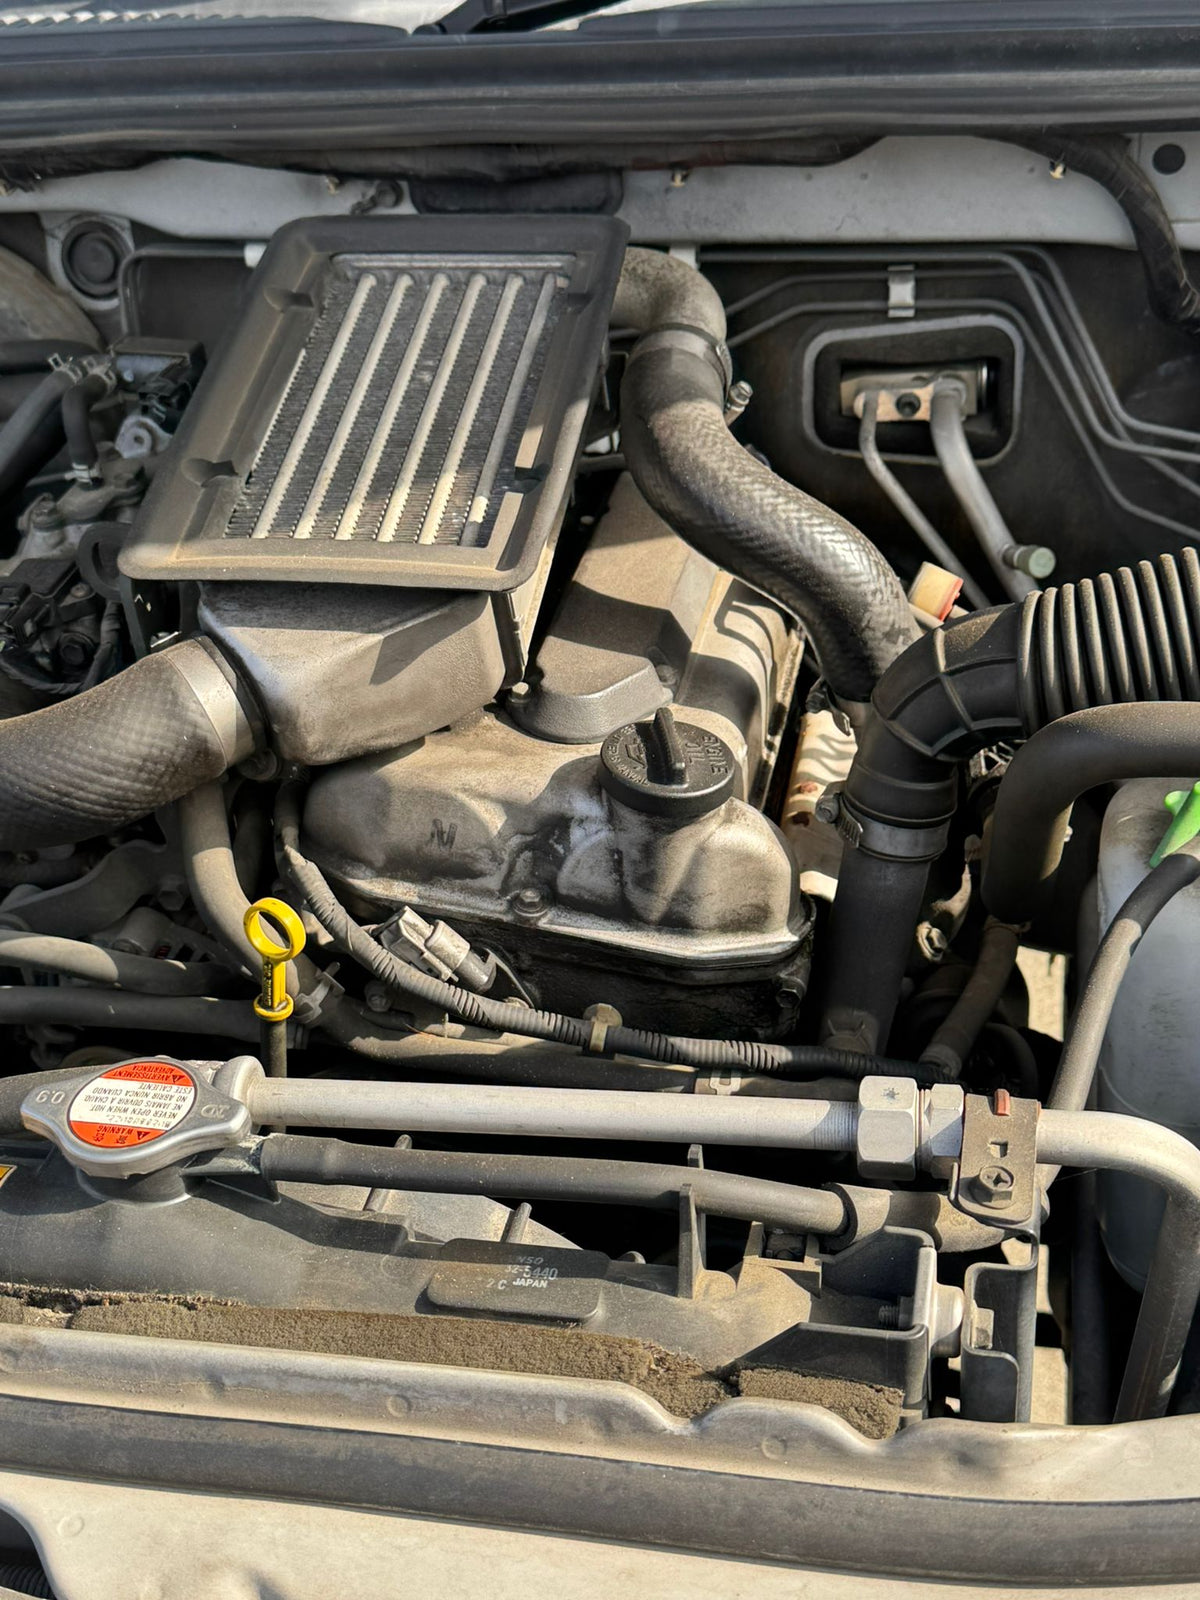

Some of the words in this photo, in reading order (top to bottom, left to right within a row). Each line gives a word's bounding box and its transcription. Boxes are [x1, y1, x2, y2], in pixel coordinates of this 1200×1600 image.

[685, 741, 705, 765] OIL
[701, 735, 729, 775] ENGINE
[132, 1066, 175, 1074] ADVERTENCIA
[112, 1070, 172, 1081] AVERTISSEMENT
[92, 1087, 122, 1095] CUANDO
[125, 1090, 150, 1098] NUNCA
[36, 1089, 65, 1105] 0.9
[152, 1093, 175, 1101] ABRIR
[118, 1098, 144, 1106] OUVRIR
[145, 1100, 172, 1109] JAMAIS
[106, 1106, 129, 1114] WHEN
[132, 1108, 151, 1116] OPEN
[153, 1110, 178, 1119] NEVER
[97, 1126, 134, 1135] WARNING
[513, 1278, 548, 1288] JAPAN
